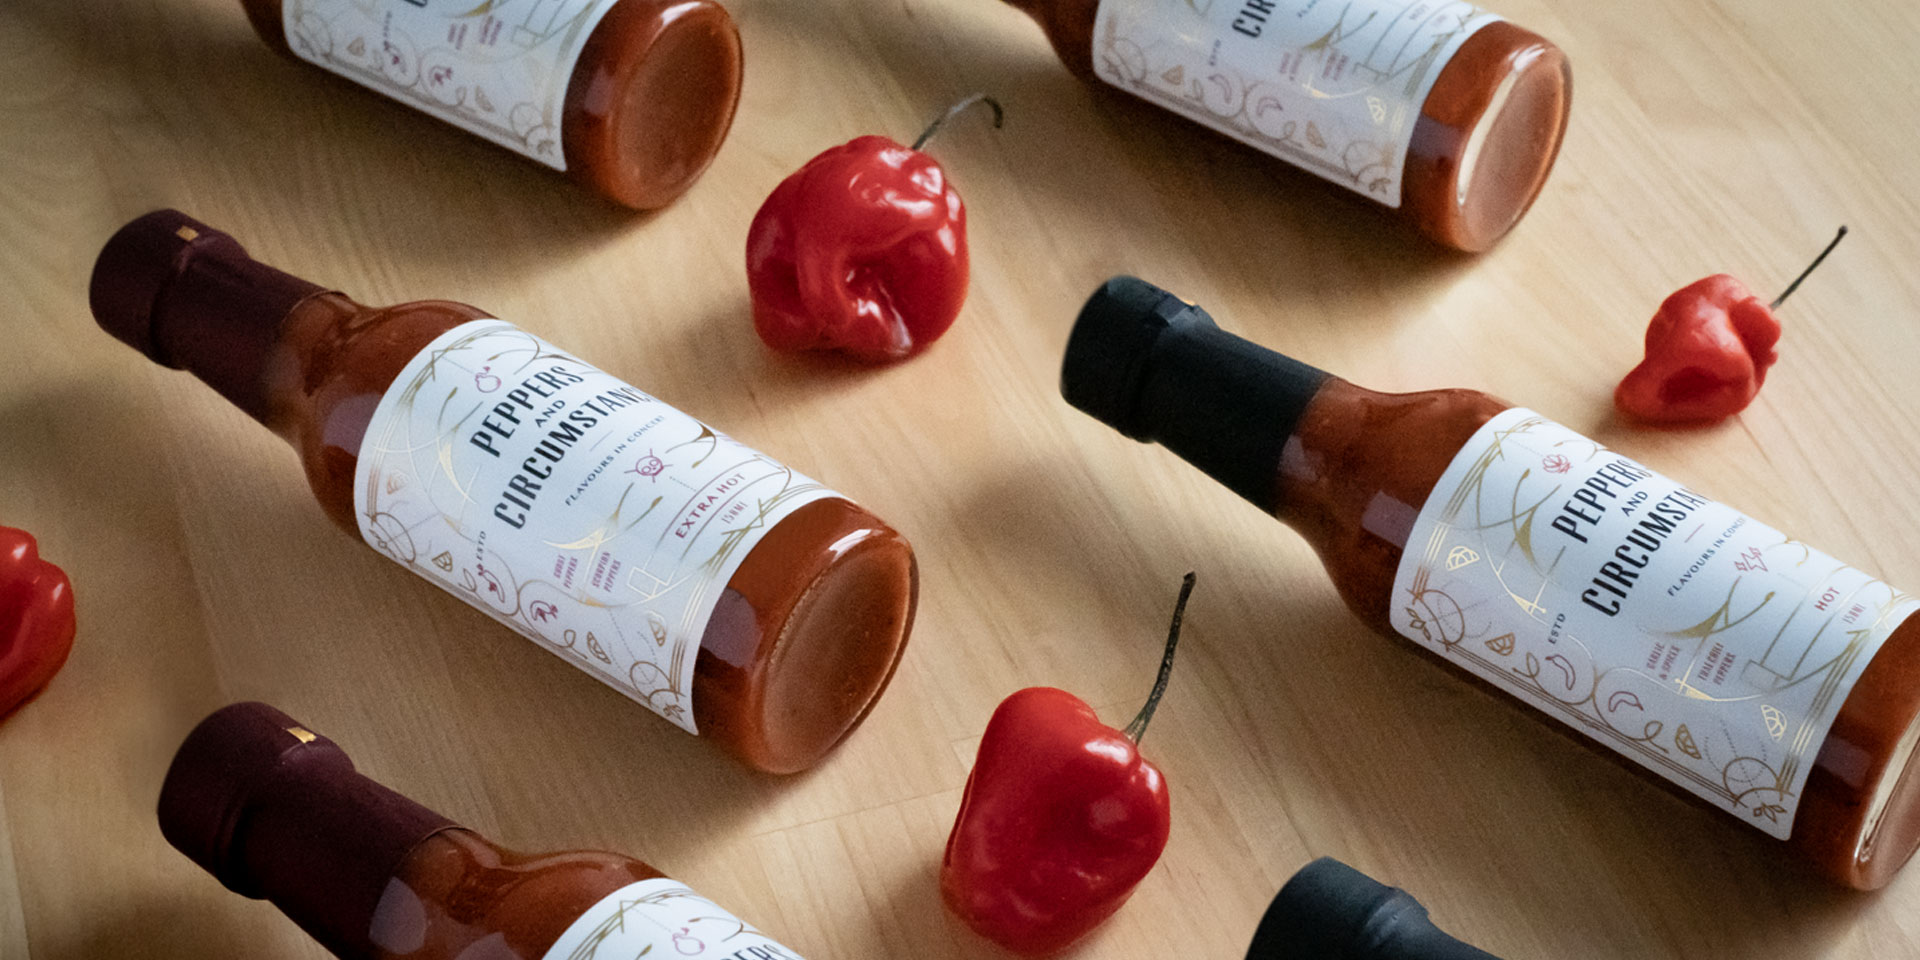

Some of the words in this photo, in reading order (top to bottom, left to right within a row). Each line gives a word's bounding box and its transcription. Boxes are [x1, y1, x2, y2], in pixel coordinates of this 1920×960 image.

[469, 365, 584, 458] PEPPERS
[535, 399, 566, 428] AND
[565, 455, 614, 506] FLAVOURS
[614, 443, 627, 454] IN
[675, 494, 719, 539] EXTRA
[717, 471, 746, 494] HOT
[1551, 459, 1653, 544] PEPPERS
[1621, 491, 1648, 517] AND
[1667, 548, 1716, 597] FLAVOURS
[1713, 537, 1726, 549] IN
[1814, 587, 1841, 612] HOT
[1548, 613, 1566, 644] ESTD
[1713, 652, 1736, 685] PEPPERS
